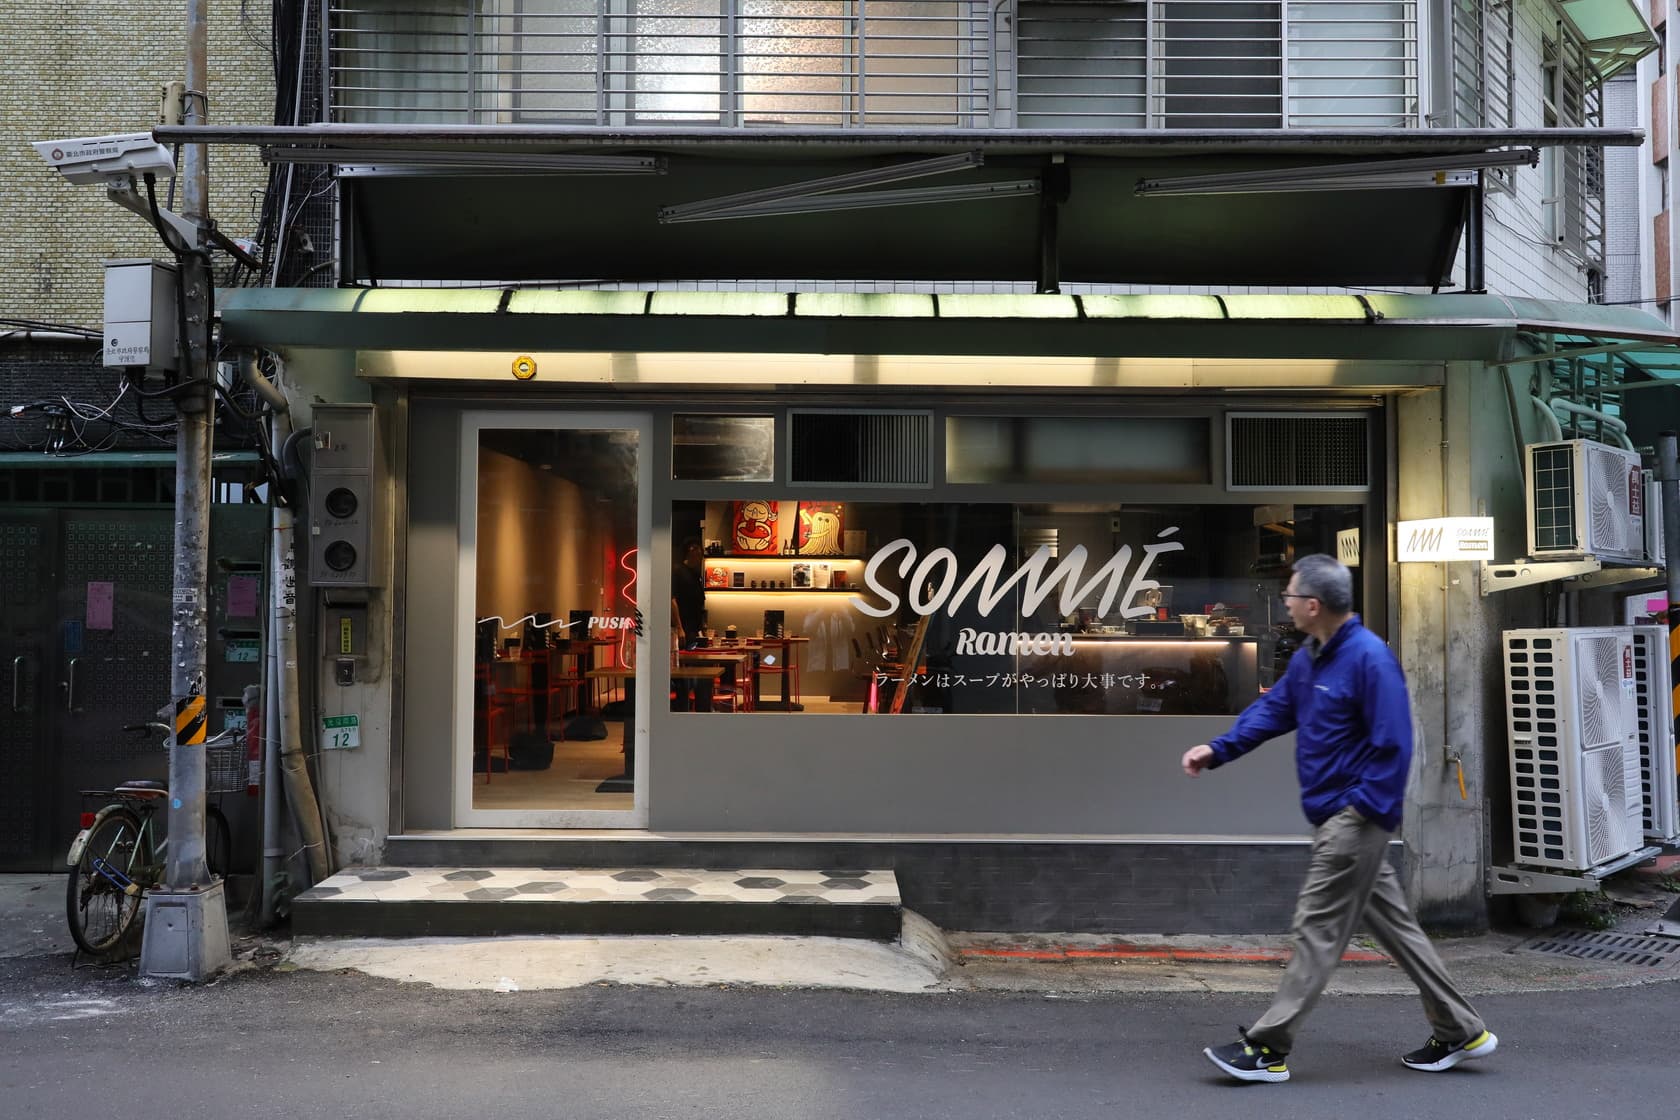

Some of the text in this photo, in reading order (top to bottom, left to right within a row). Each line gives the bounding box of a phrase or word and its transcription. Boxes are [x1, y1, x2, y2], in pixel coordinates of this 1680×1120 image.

[849, 526, 1185, 619] SOMMÉ
[588, 616, 631, 630] PUSH
[955, 627, 1076, 657] Ramen
[875, 671, 1157, 690] ラーメンはスープがやっぱり大事です。
[332, 732, 350, 747] 12
